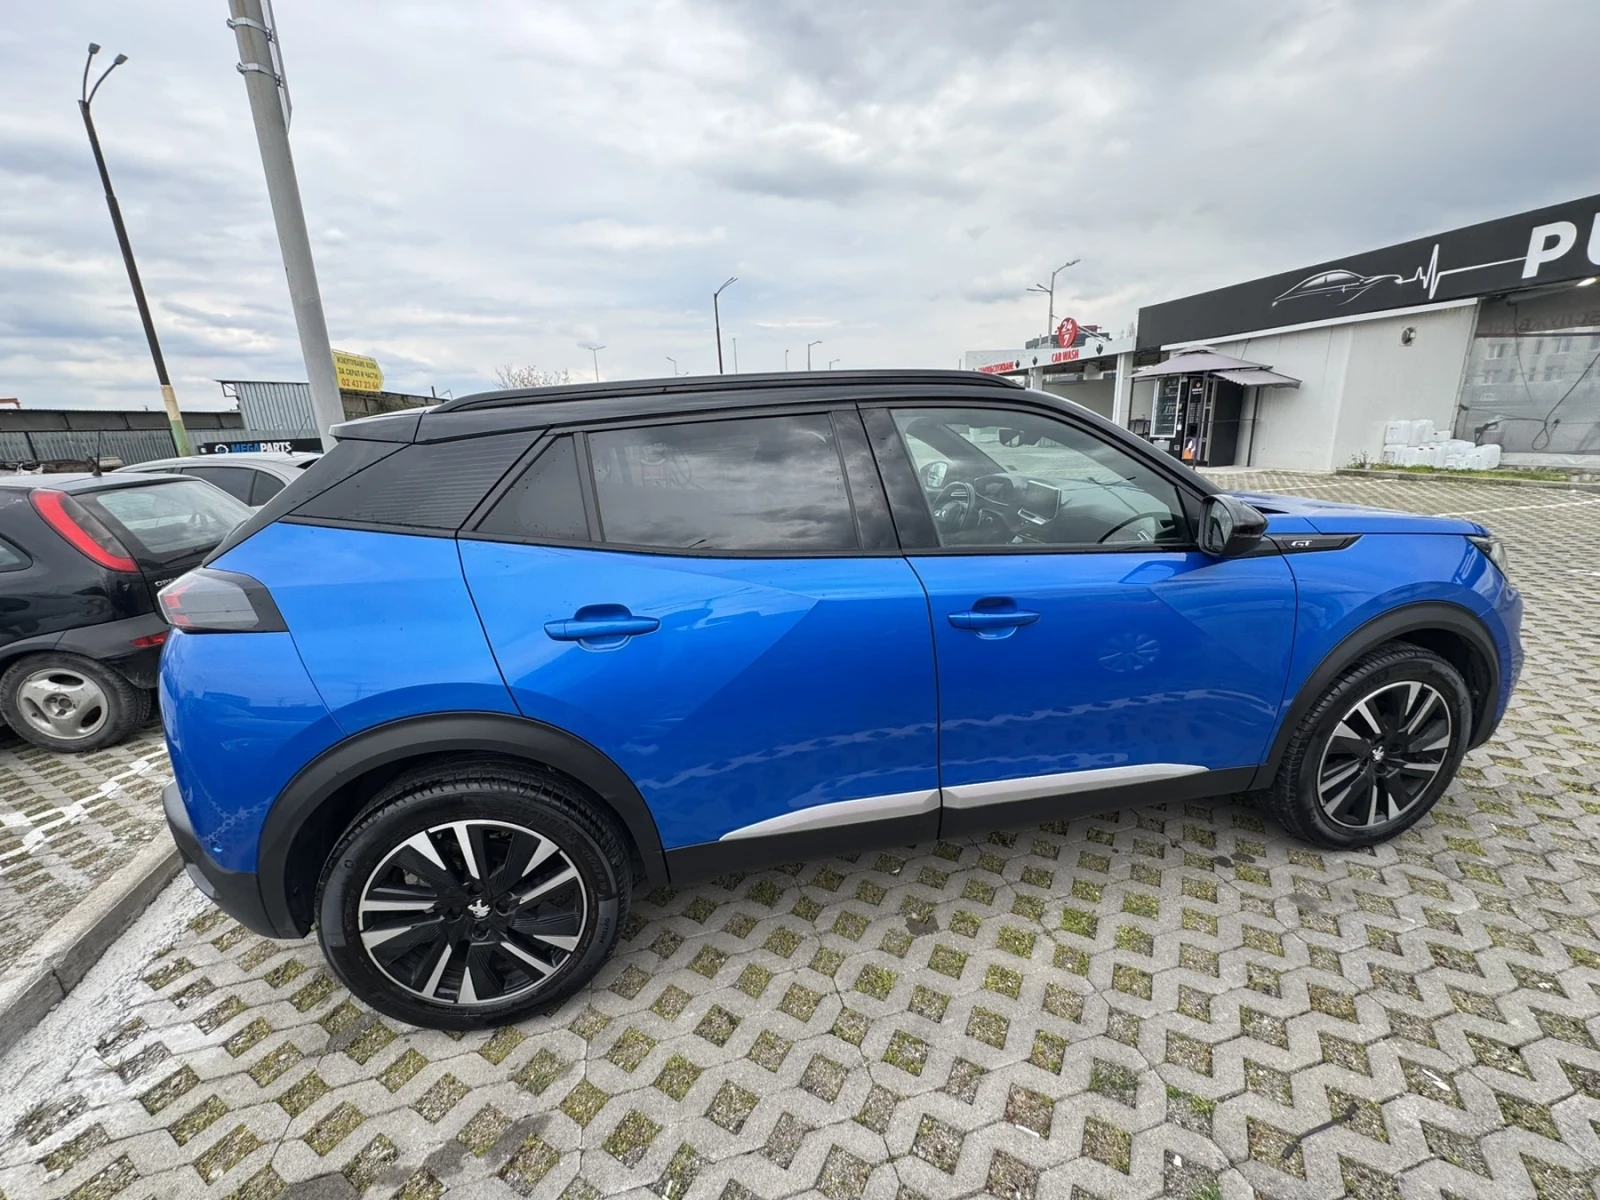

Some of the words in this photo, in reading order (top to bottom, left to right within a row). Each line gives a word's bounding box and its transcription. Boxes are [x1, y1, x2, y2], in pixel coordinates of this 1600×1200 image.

[1062, 320, 1073, 332] 24
[1063, 334, 1069, 346] 7
[1051, 352, 1061, 362] CAR
[1062, 349, 1079, 360] WASH
[341, 378, 350, 387] 02
[351, 379, 362, 388] 437
[363, 381, 371, 389] 23
[231, 442, 292, 453] MEGAPARTS
